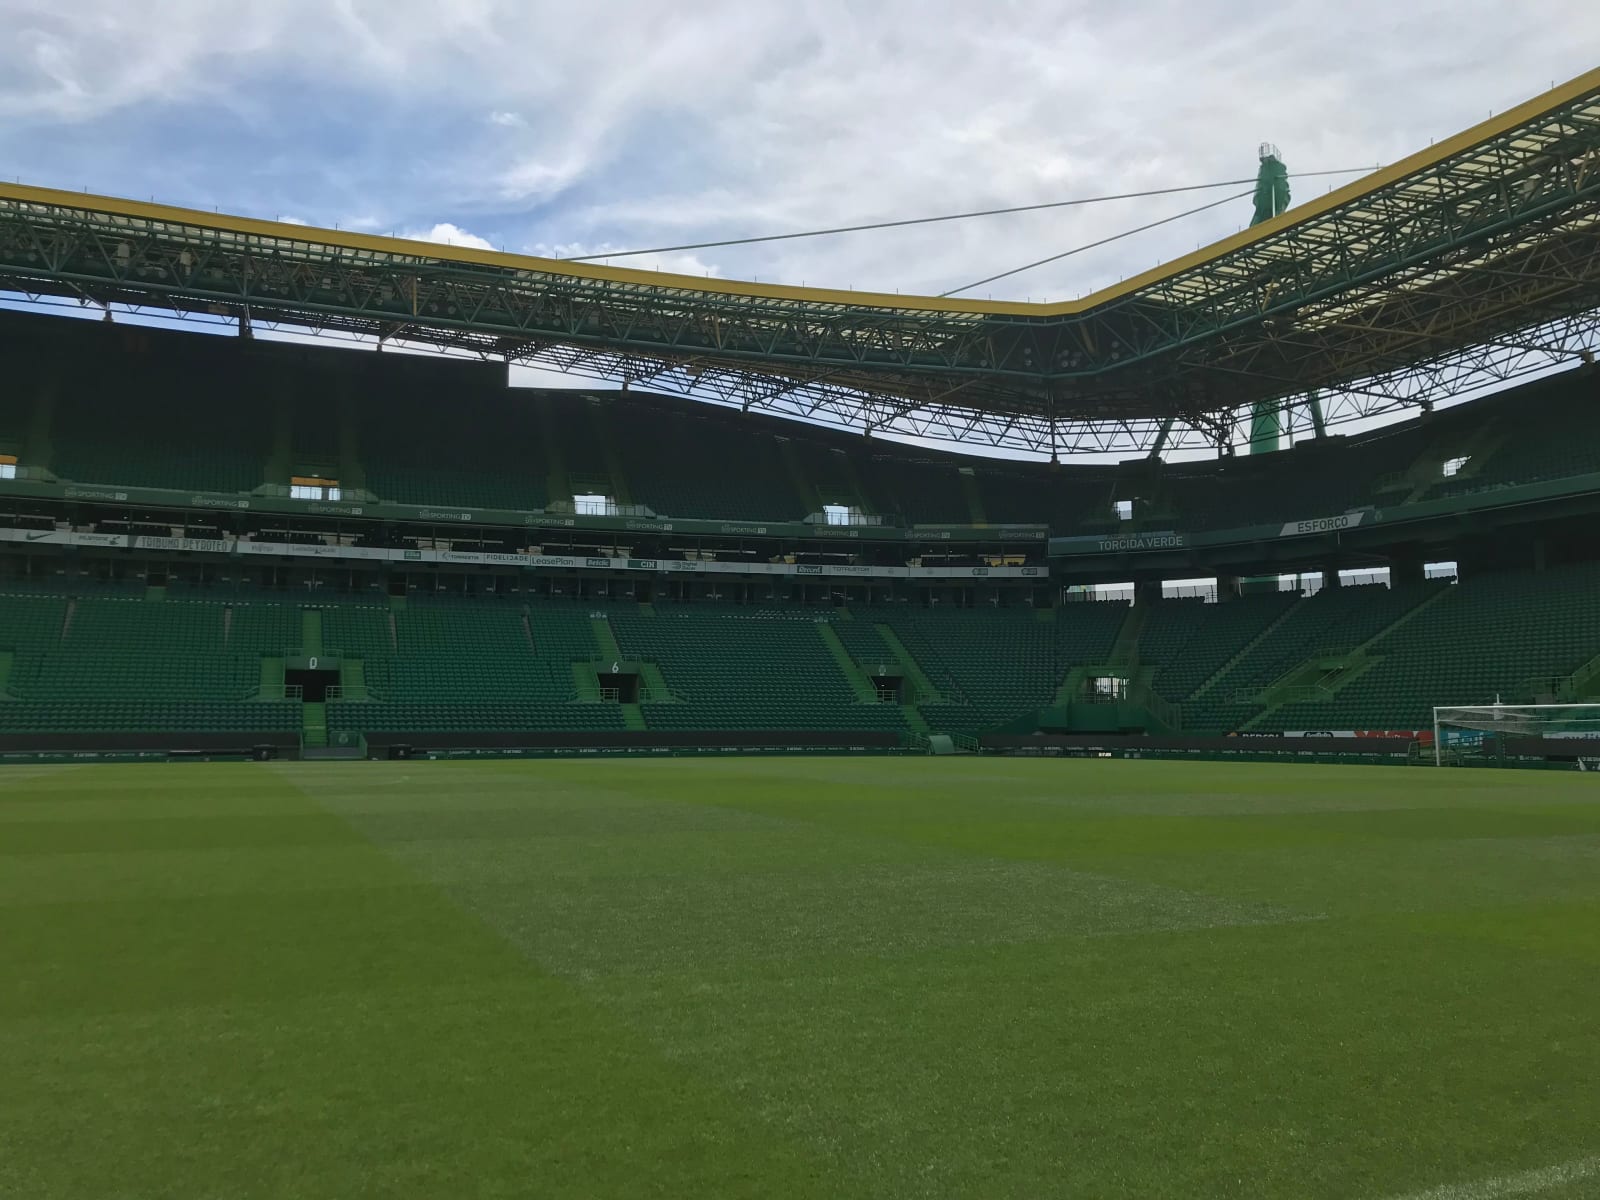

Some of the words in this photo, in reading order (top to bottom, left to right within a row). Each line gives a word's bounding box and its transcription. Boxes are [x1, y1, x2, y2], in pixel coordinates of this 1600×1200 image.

[1098, 538, 1144, 552] TORCIDA
[1146, 536, 1183, 548] VERDE
[531, 557, 574, 566] LeasePlan
[612, 662, 619, 674] 6
